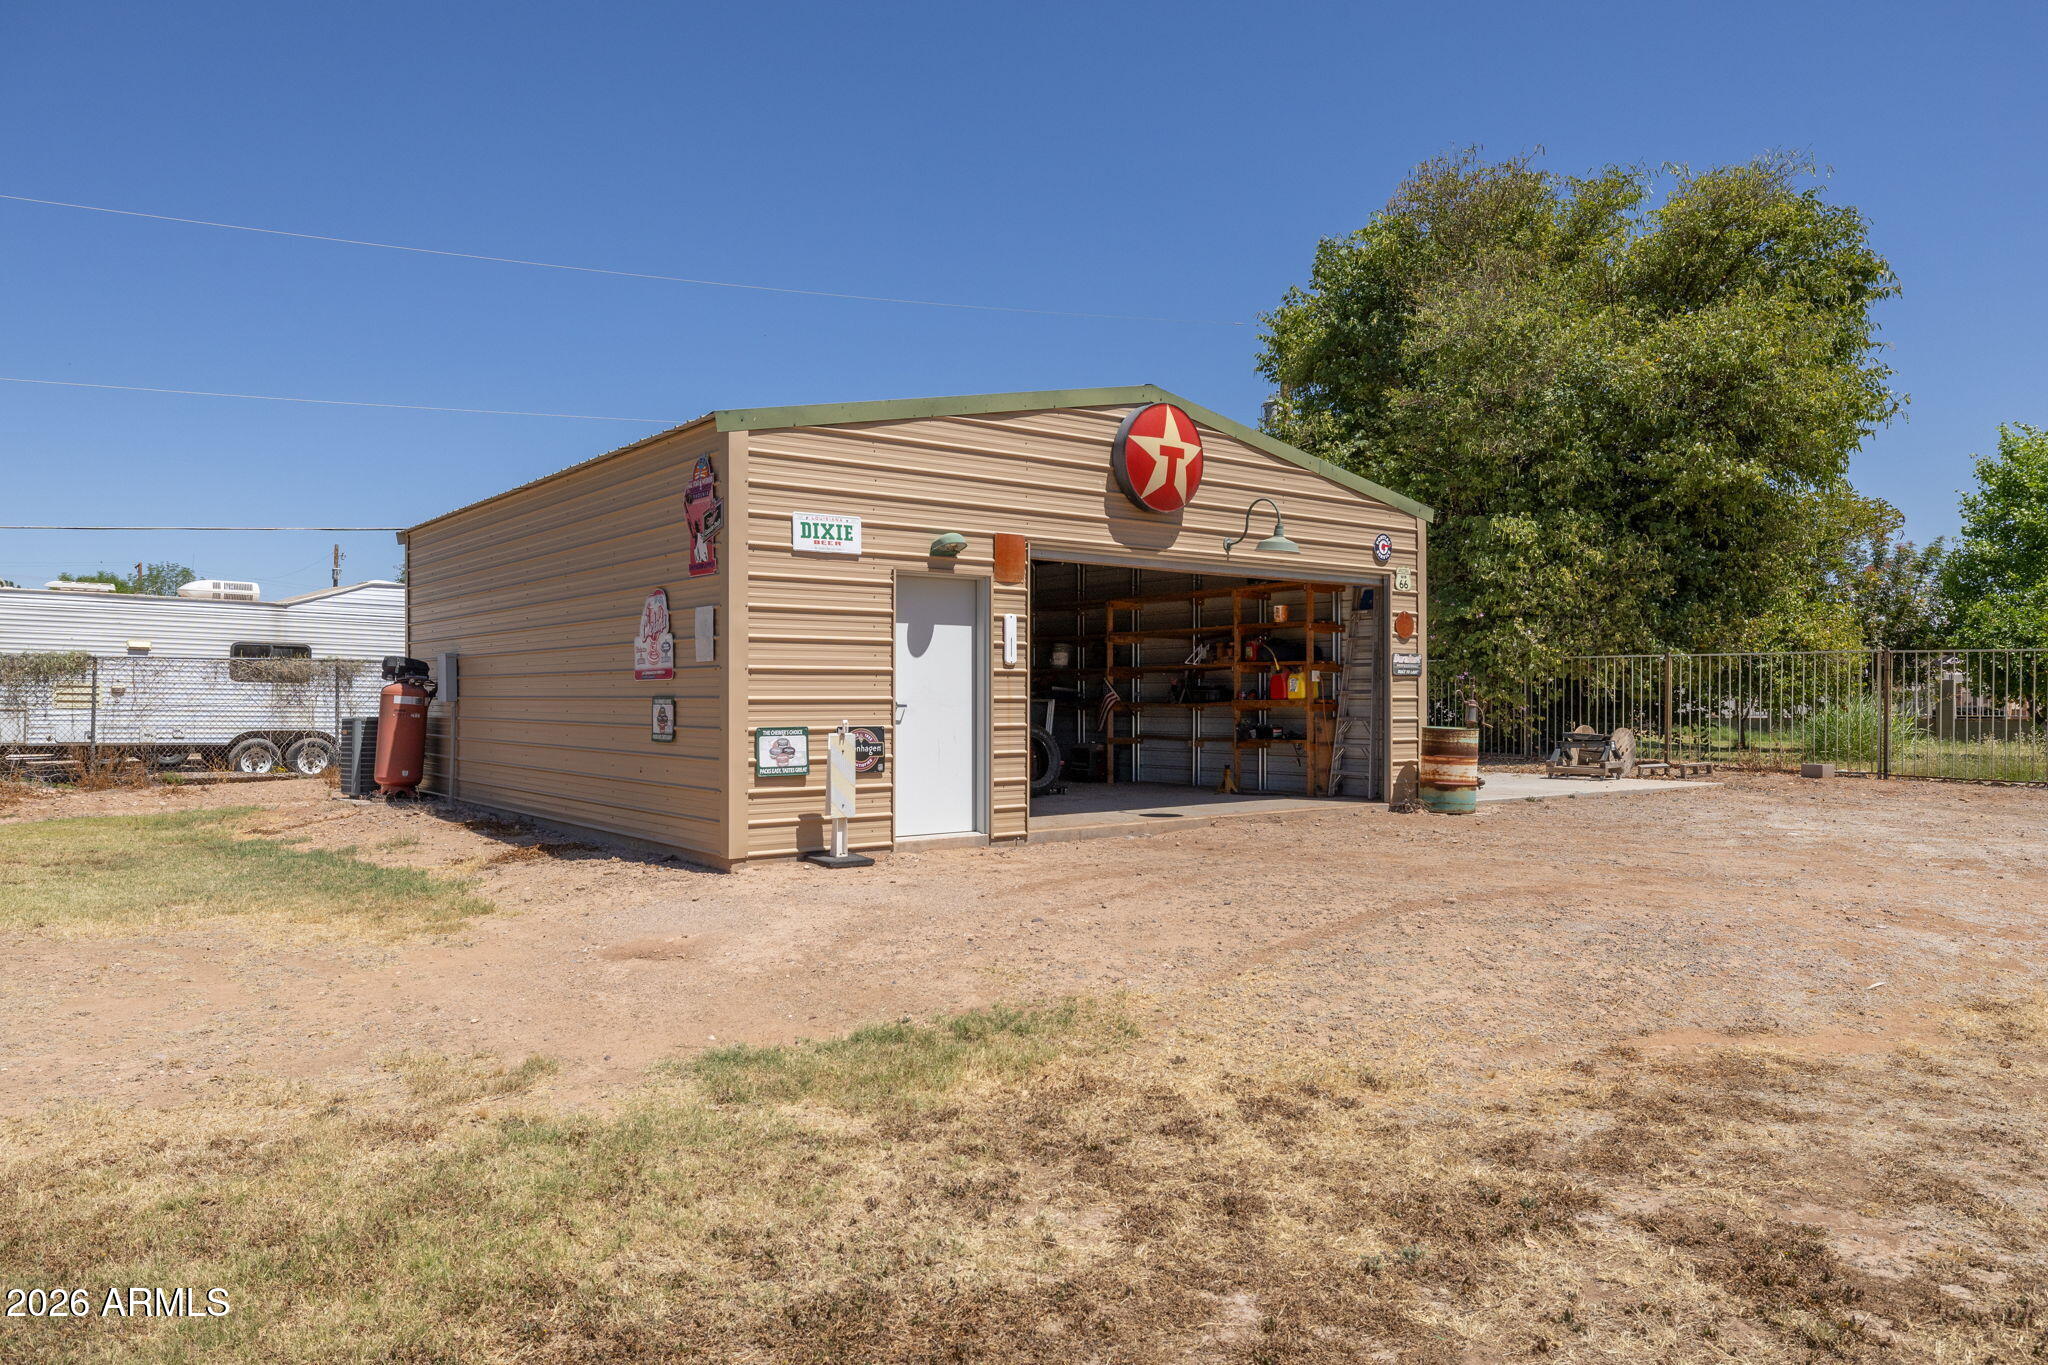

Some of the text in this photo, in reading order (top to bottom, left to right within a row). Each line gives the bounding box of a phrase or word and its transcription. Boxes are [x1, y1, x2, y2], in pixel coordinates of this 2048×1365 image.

[1160, 445, 1184, 486] T
[800, 521, 854, 541] DIXIE
[1399, 579, 1409, 589] 66
